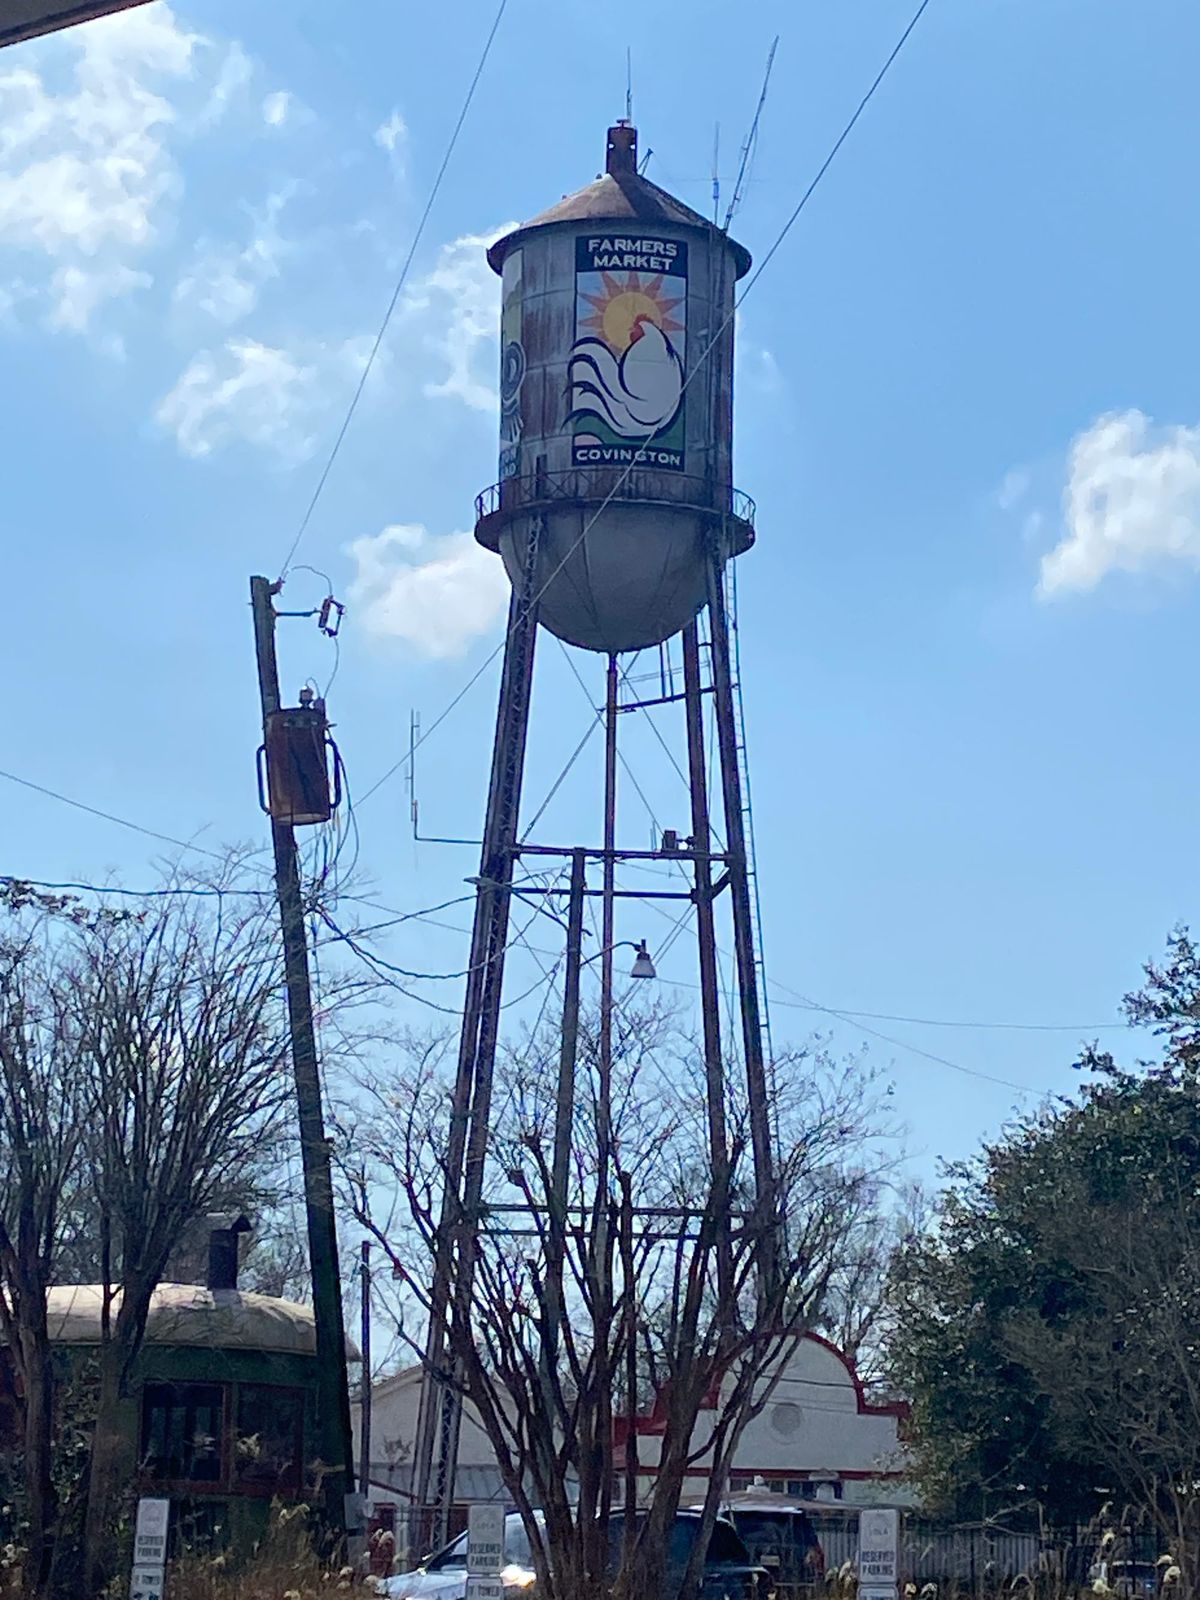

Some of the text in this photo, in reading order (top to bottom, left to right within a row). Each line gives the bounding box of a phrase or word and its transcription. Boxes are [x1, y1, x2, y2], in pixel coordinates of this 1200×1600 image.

[588, 238, 678, 256] FARMERS
[594, 255, 673, 270] MARKET
[576, 449, 681, 465] COVINGTON
[470, 1543, 501, 1554] RESERVED
[470, 1555, 500, 1566] PARKING
[861, 1550, 895, 1562] RESERVED
[862, 1564, 894, 1576] PARKING
